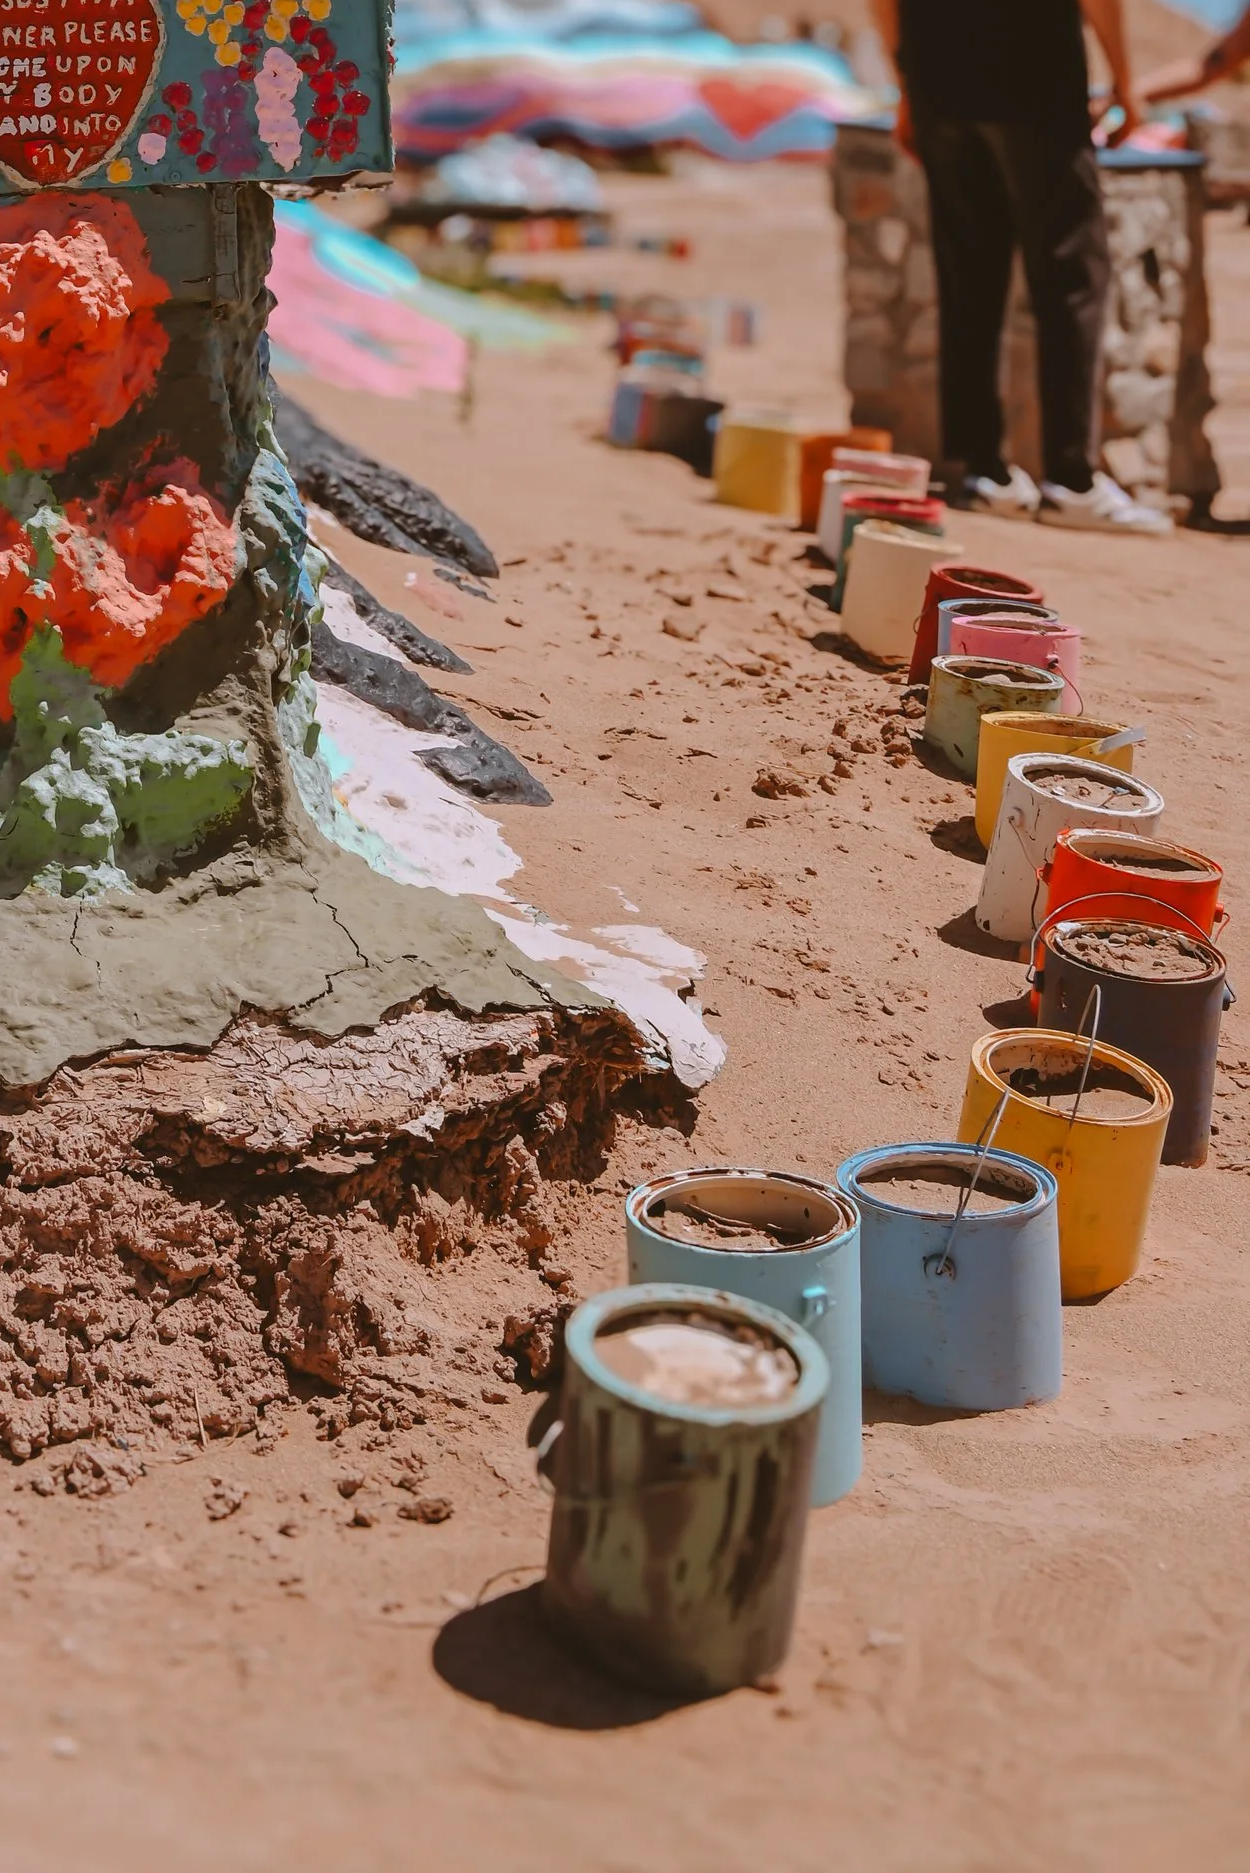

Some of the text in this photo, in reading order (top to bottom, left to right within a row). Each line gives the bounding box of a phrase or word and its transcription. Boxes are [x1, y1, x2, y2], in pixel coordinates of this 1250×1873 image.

[64, 20, 154, 45] PLEASE
[54, 54, 137, 76] UPON
[33, 82, 124, 108] BODY
[62, 112, 122, 137] INTO
